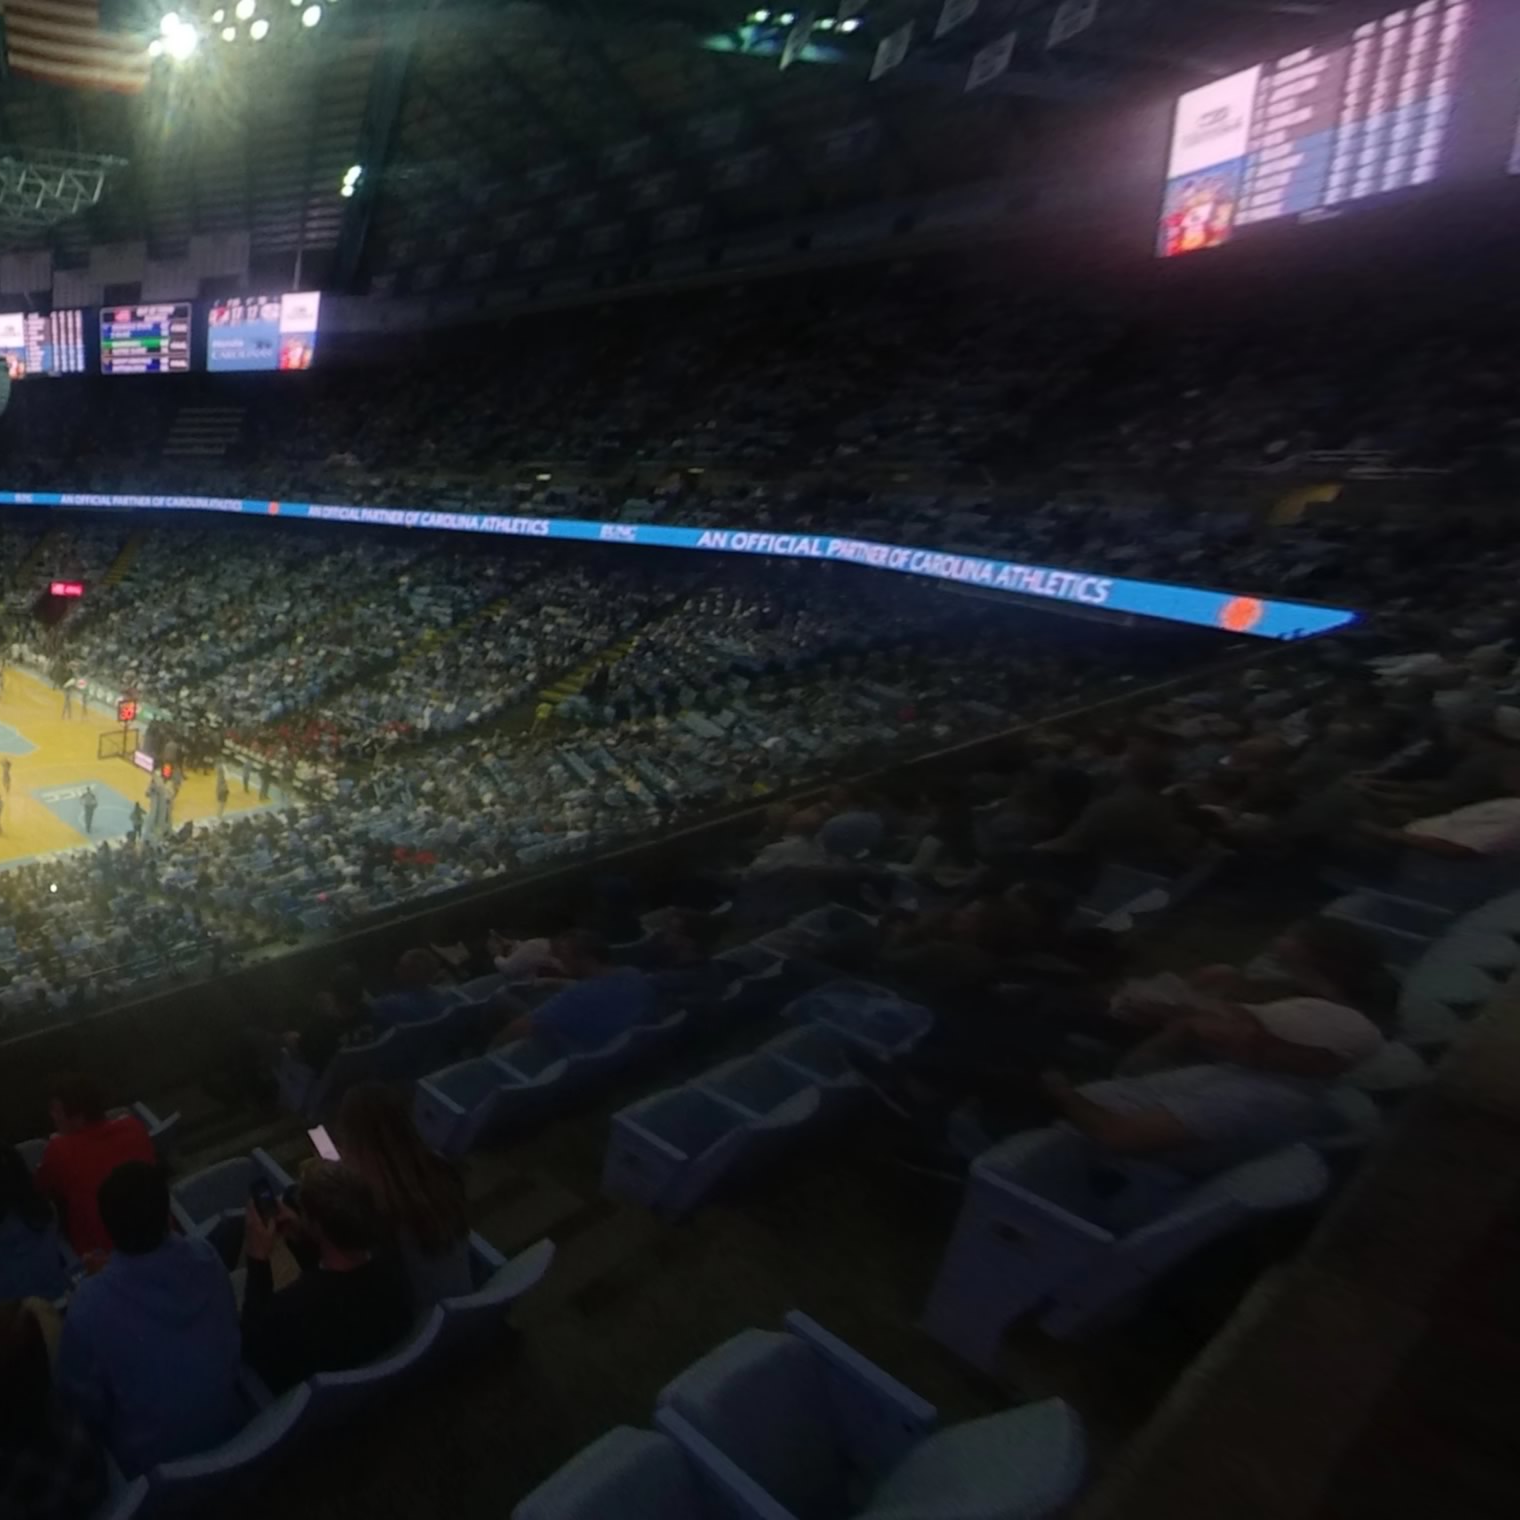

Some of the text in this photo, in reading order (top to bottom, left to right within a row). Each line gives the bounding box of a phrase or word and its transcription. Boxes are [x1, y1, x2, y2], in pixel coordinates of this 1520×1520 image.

[420, 511, 478, 531] CAROLINA
[480, 515, 549, 535] ATHLETICS
[696, 530, 1112, 603] AN OFFICIAL PARTNER OF CAROLINA ATHLETICS
